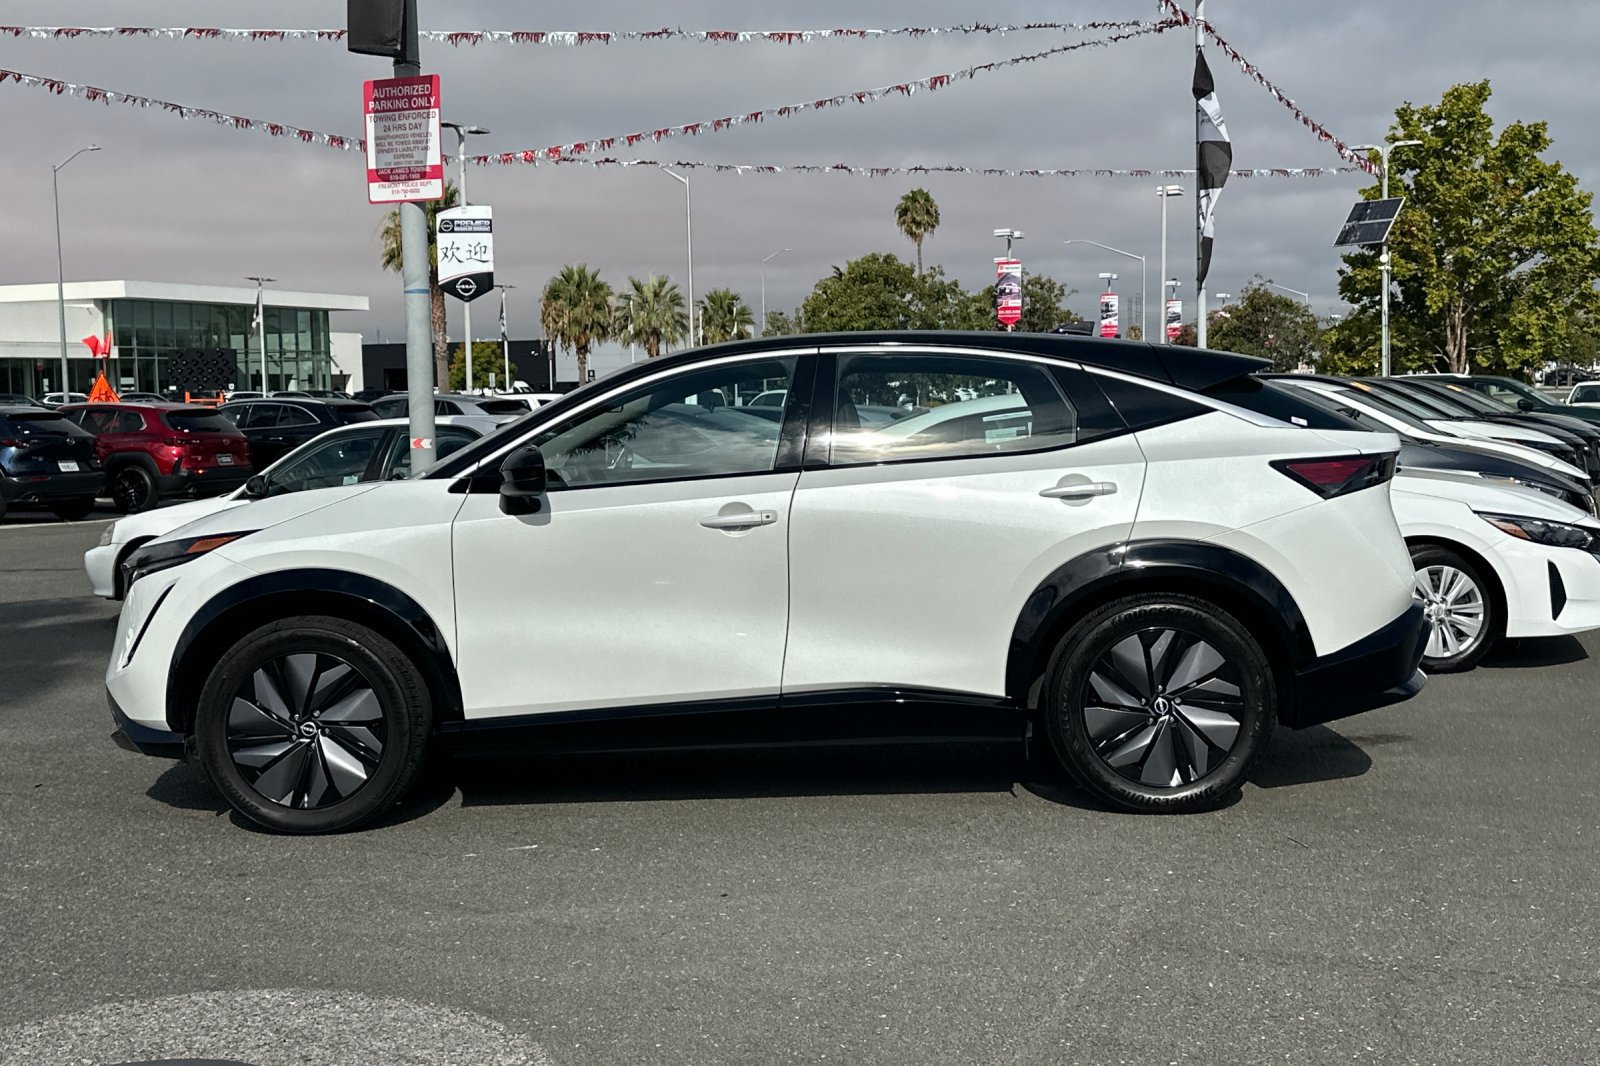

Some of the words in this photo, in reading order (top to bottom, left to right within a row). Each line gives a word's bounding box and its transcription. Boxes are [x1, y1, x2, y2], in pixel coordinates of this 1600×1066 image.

[373, 84, 431, 99] AUTHORIZED
[368, 98, 409, 112] PARKING
[411, 96, 436, 108] ONLY
[368, 113, 397, 123] TOWING
[398, 111, 437, 121] ENFORCED
[393, 123, 407, 131] HRS
[409, 122, 423, 130] DAY
[440, 240, 490, 263] 欢迎
